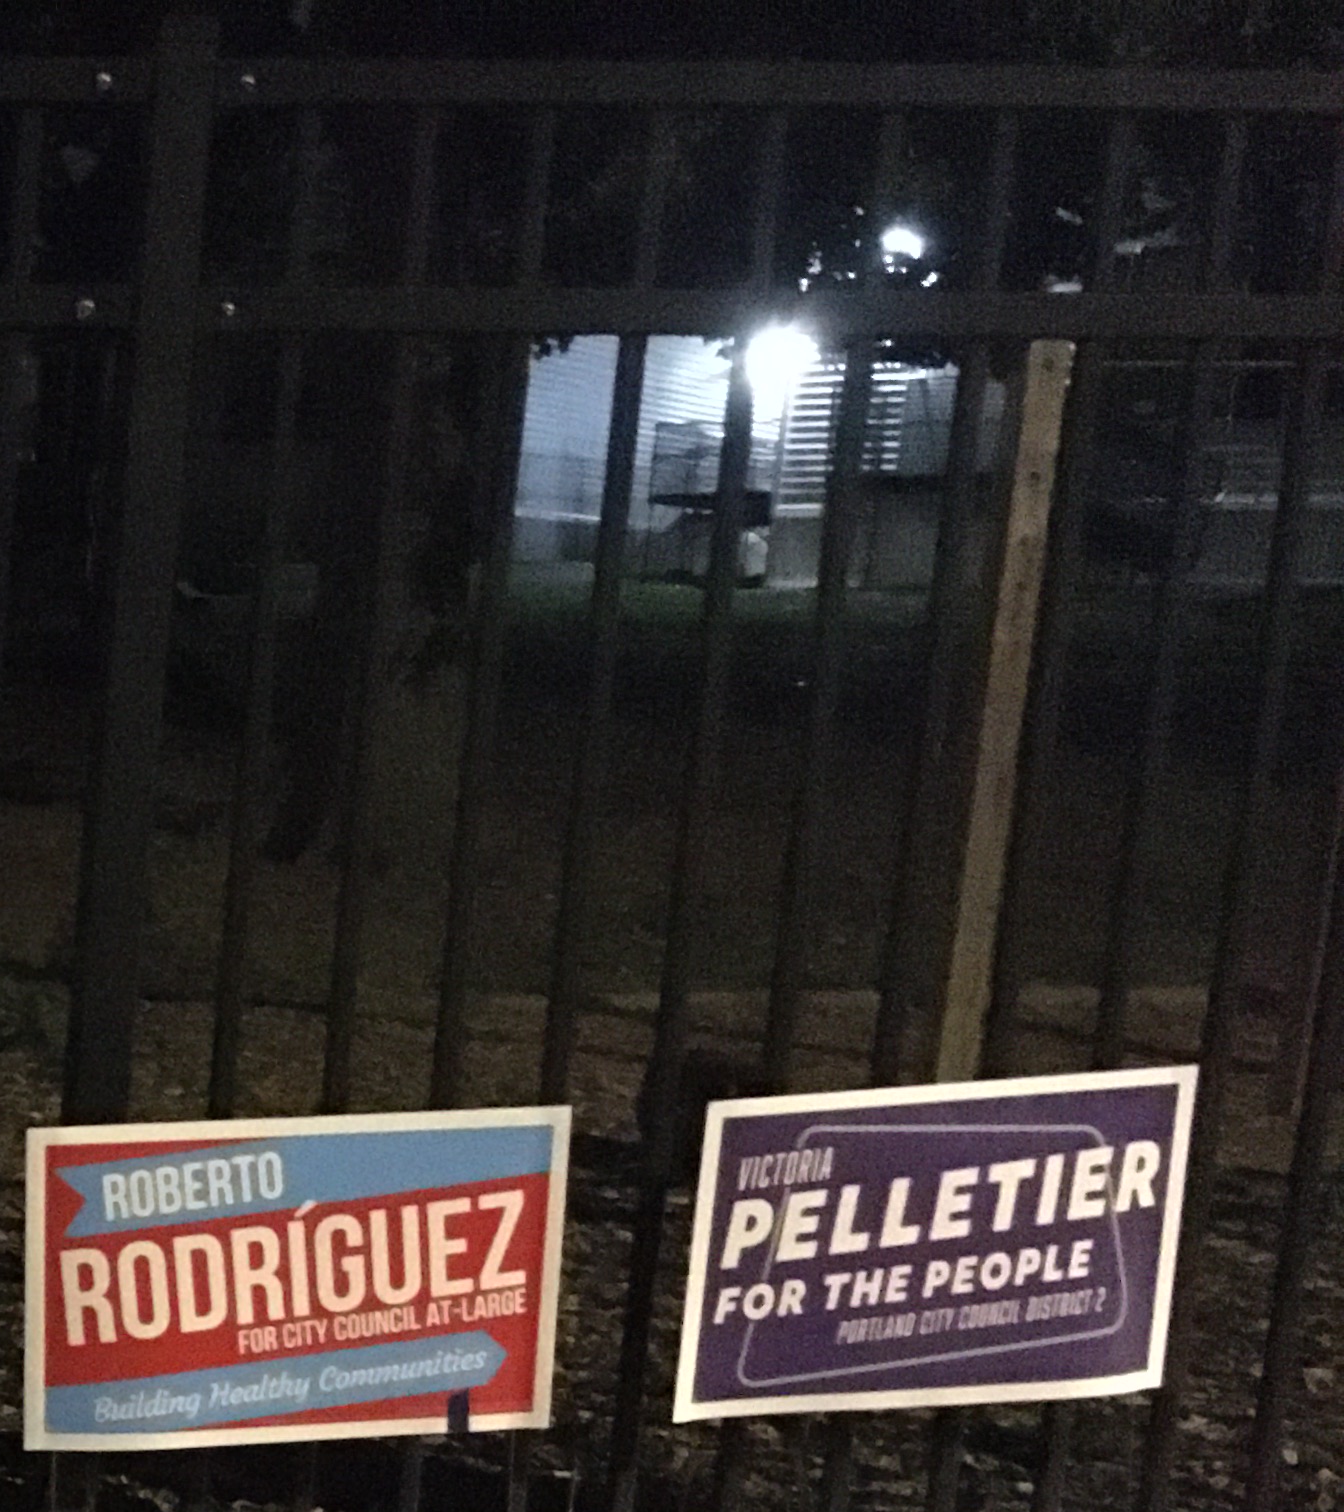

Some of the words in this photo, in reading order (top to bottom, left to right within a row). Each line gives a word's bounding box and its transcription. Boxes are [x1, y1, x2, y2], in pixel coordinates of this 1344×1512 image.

[101, 1151, 284, 1222] ROBERTO
[719, 1139, 1161, 1270] PELLETIER
[738, 1147, 834, 1191] VICTORIA
[59, 1189, 527, 1347] RODRÍGUEZ
[713, 1280, 807, 1325] FOR
[823, 1264, 913, 1311] THE
[922, 1239, 1094, 1298] PEOPLE
[238, 1324, 277, 1356] FOR
[282, 1317, 328, 1352] CITY
[333, 1309, 422, 1343] COUNCIL
[426, 1288, 527, 1328] AT-LARGE
[94, 1385, 200, 1424] Building
[210, 1372, 310, 1412] Healthy
[318, 1348, 487, 1393] Communities
